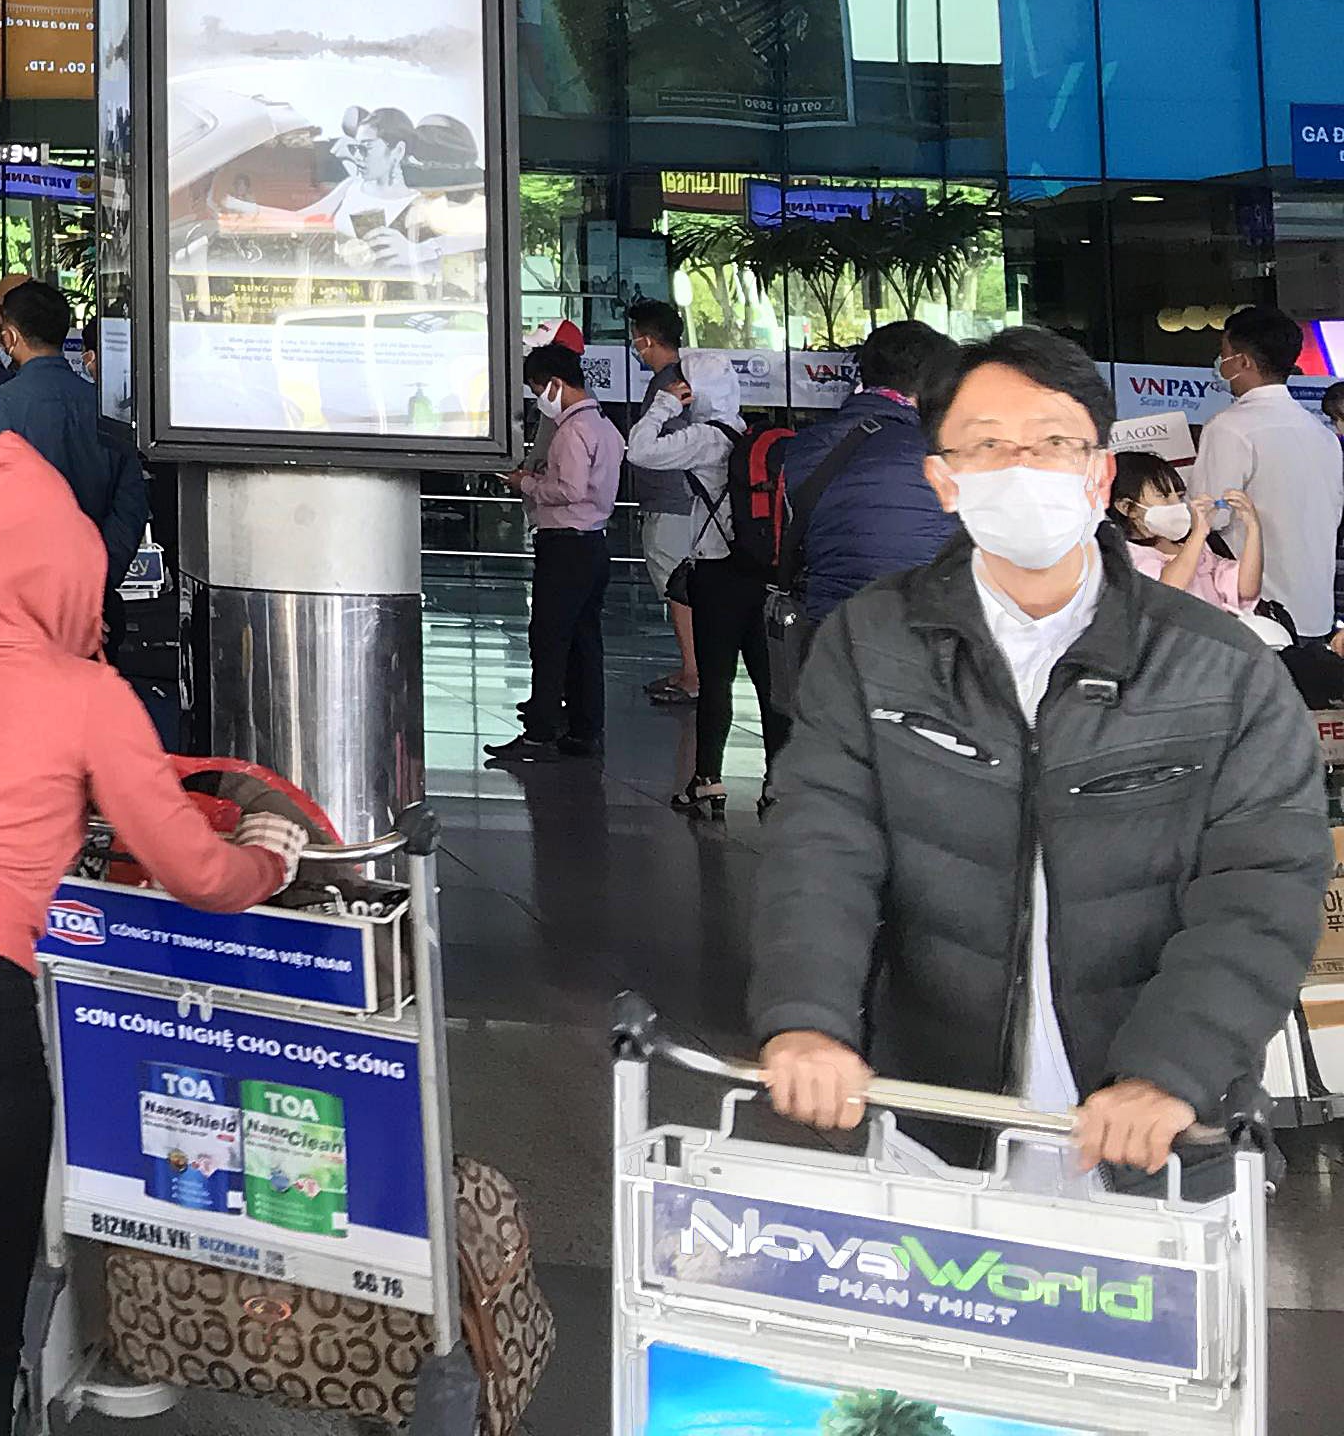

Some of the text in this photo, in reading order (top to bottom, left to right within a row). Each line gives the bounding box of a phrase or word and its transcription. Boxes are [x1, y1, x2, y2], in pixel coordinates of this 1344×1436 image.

[1302, 126, 1329, 143] GA
[1129, 377, 1210, 398] VNPAY
[1140, 396, 1201, 411] Scan to Pay
[50, 910, 100, 936] TOA
[109, 922, 150, 941] CÔNG
[152, 930, 170, 944] TY
[246, 945, 278, 961] TOA
[313, 955, 352, 972] NAM
[74, 1006, 406, 1080] SƠN CÔNG NGHỆ CHO CUỘC SỐNG
[162, 1072, 216, 1102] TOA
[143, 1100, 239, 1133] NanoShield
[264, 1092, 321, 1122] TOA
[246, 1118, 345, 1154] NanoClean
[680, 1198, 1153, 1324] NovaWorld
[818, 1275, 909, 1308] PHAN
